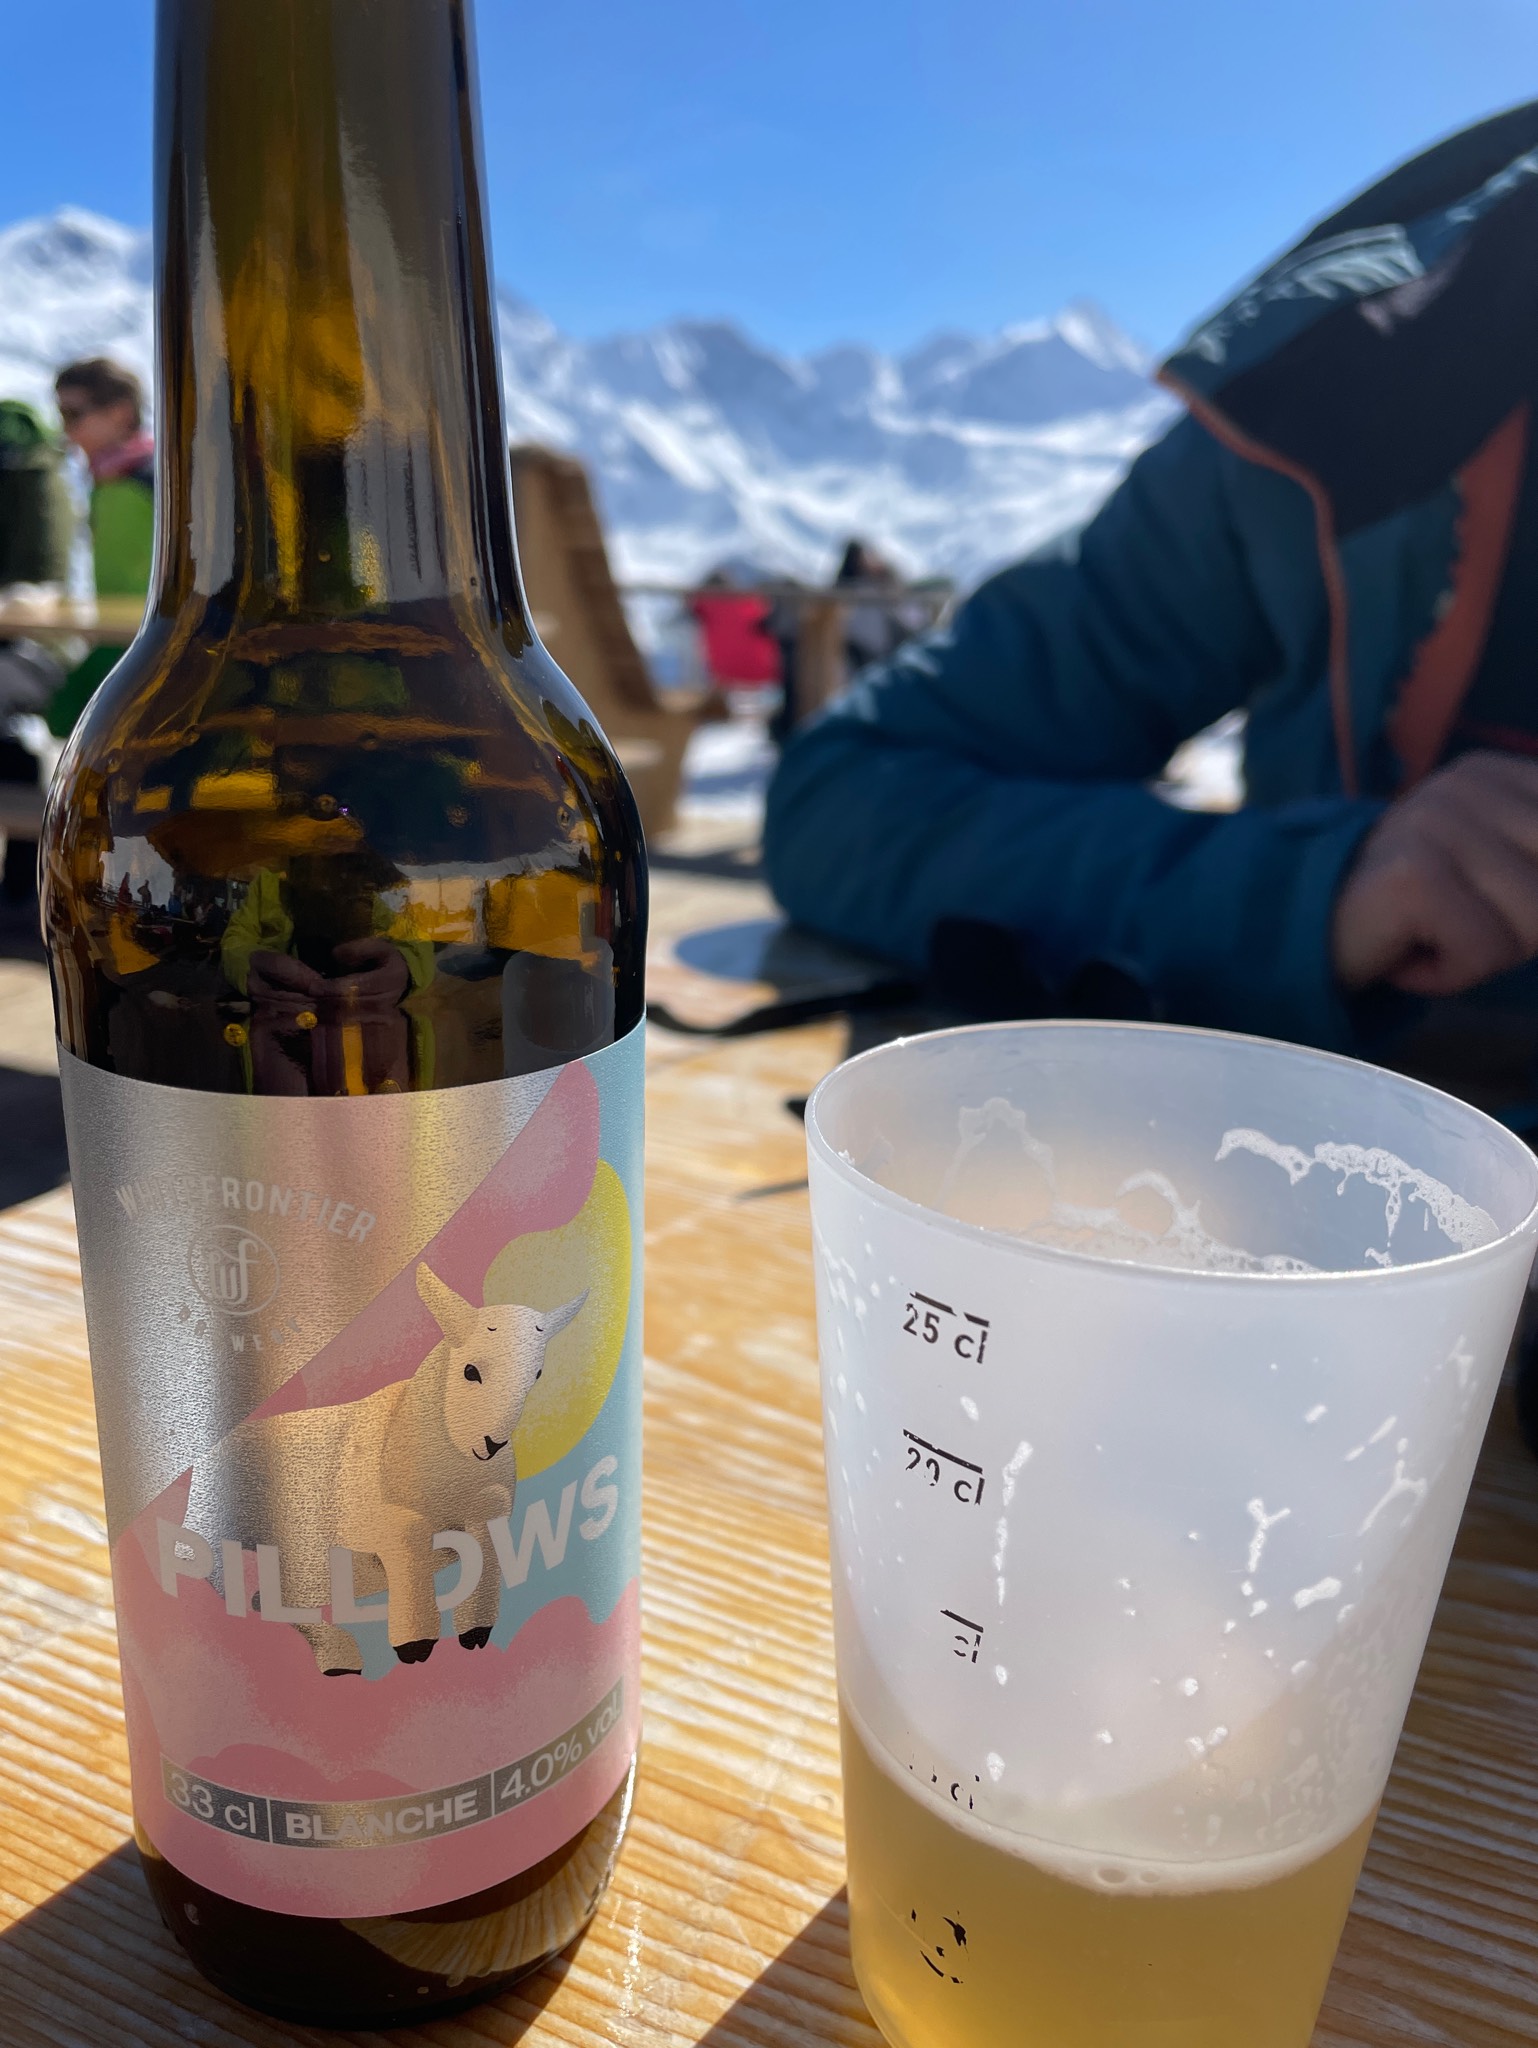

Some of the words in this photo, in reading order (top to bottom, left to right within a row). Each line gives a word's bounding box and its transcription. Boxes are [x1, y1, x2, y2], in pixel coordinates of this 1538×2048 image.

[903, 1303, 940, 1344] 25
[954, 1330, 988, 1364] cl
[954, 1477, 985, 1505] cl
[500, 1735, 583, 1801] 4.0%
[171, 1773, 215, 1819] 33
[224, 1801, 257, 1834] cl
[285, 1790, 479, 1840] BLANCHE
